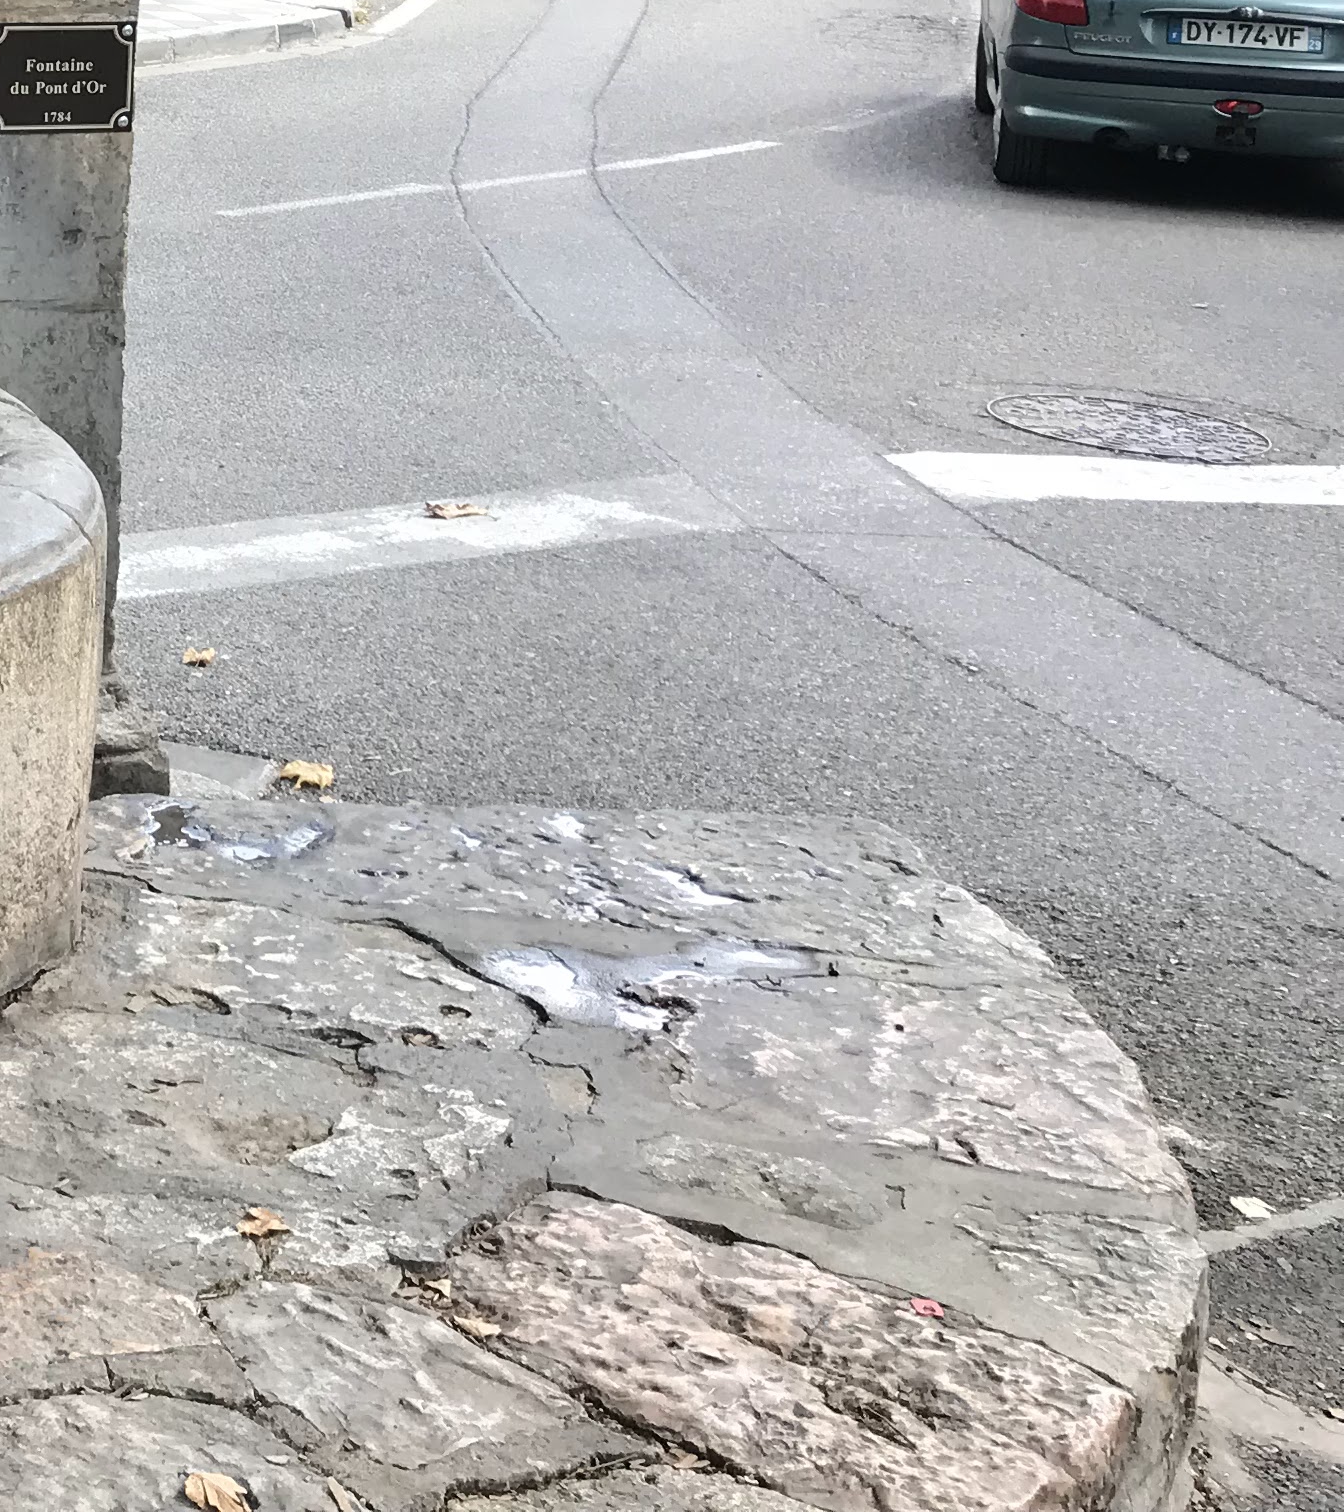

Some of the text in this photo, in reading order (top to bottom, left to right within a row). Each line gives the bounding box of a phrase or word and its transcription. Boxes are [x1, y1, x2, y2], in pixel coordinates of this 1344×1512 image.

[1186, 20, 1305, 47] DY-174-VF
[1308, 39, 1321, 51] 29
[25, 58, 94, 73] Fontaine
[10, 80, 107, 95] du Pont d'Or
[43, 111, 72, 123] 1784
